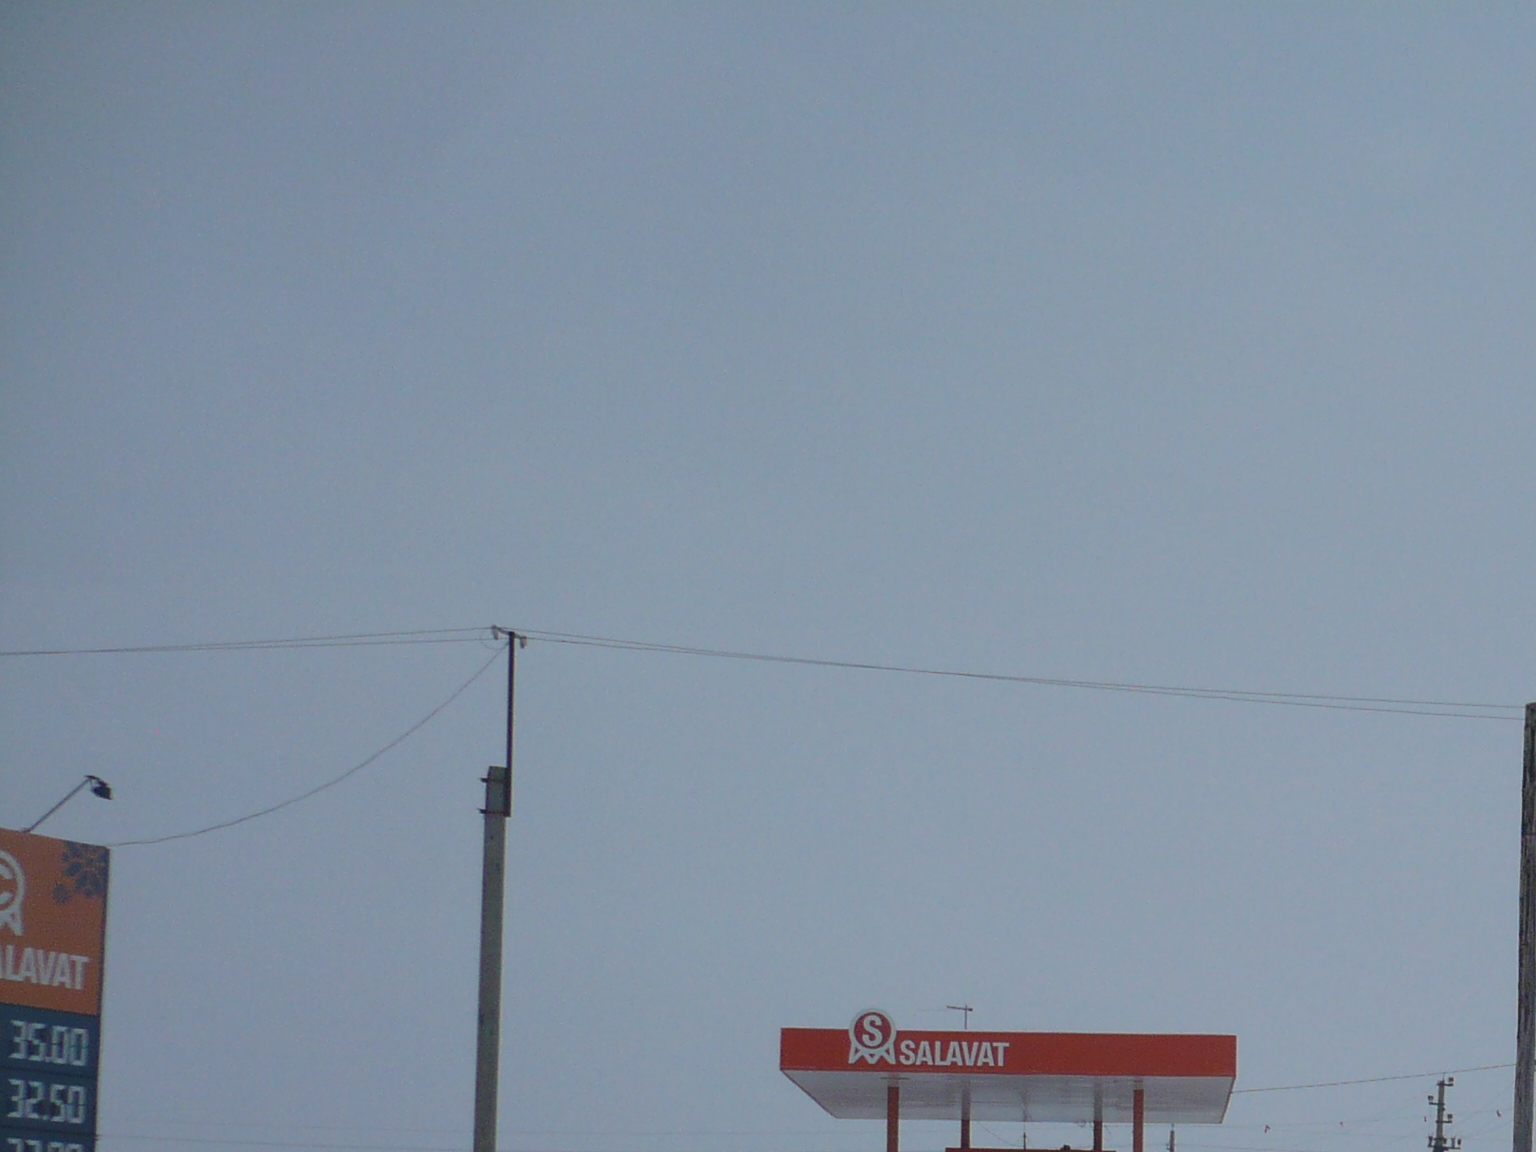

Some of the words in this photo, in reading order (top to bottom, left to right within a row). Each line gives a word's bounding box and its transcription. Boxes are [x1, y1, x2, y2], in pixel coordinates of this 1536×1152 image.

[8, 1020, 89, 1067] 35.00
[900, 1040, 1009, 1066] SALAVAT
[6, 1079, 85, 1124] 32.50
